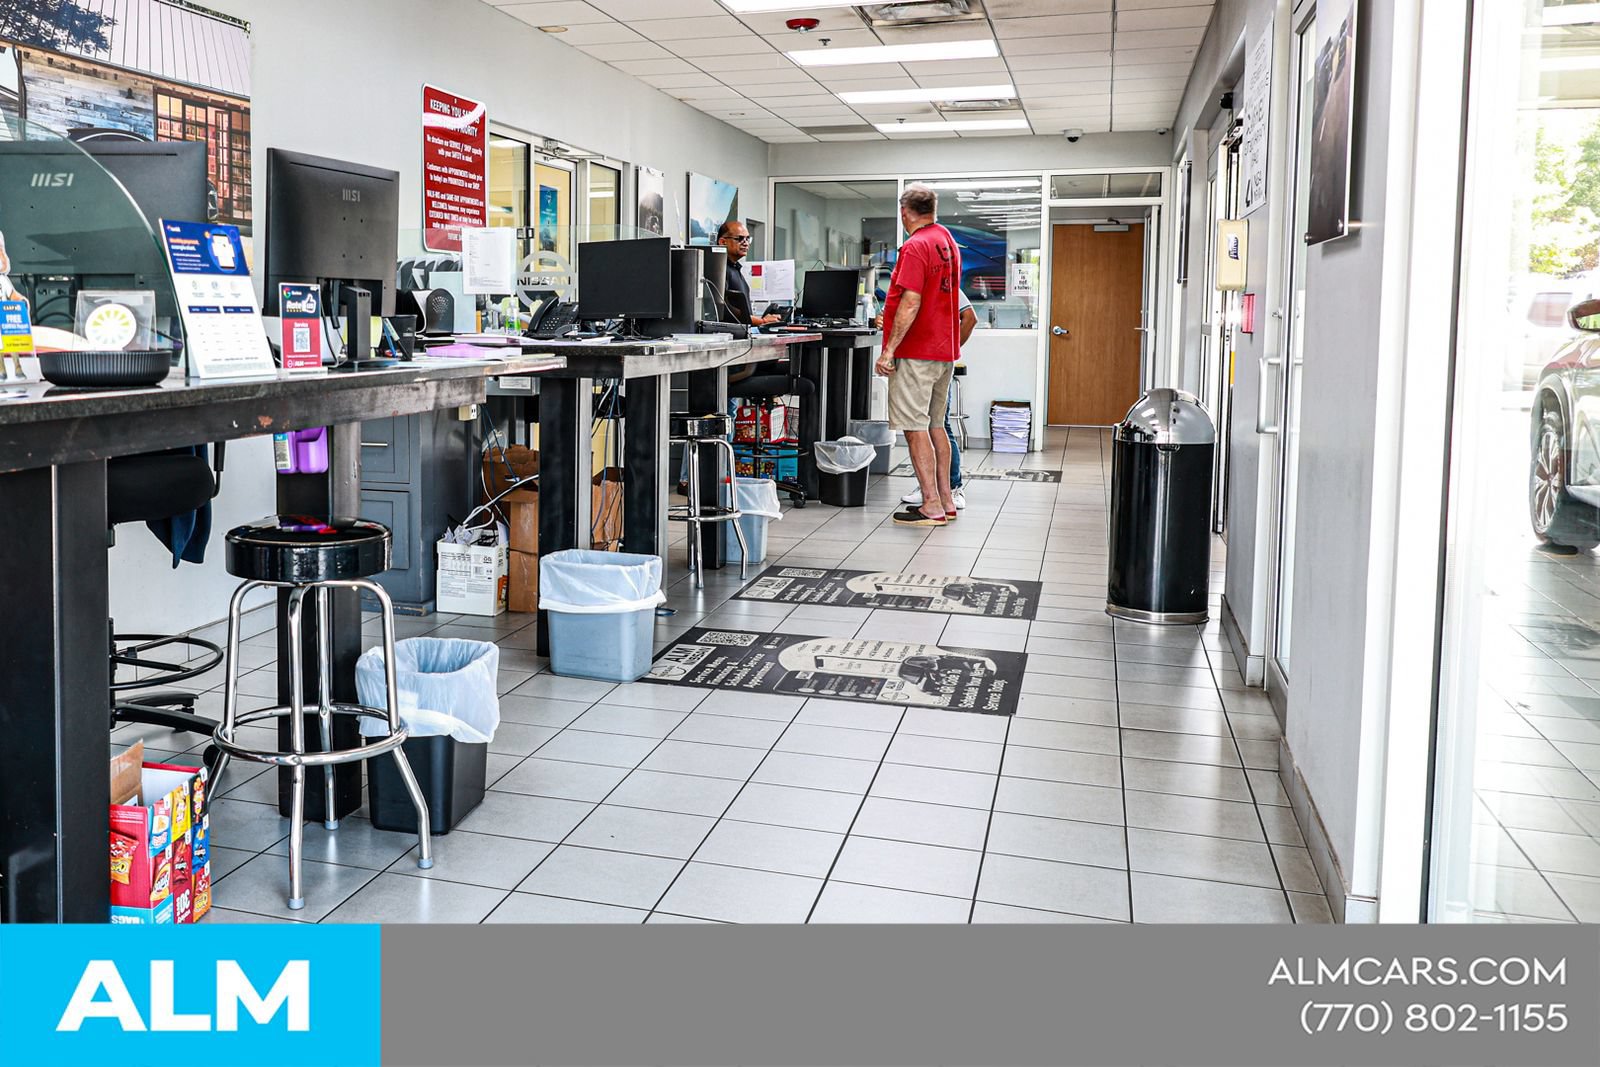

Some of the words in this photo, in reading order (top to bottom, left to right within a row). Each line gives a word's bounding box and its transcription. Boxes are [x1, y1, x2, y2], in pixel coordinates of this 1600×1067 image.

[31, 173, 74, 187] MSI
[342, 188, 361, 202] MSI
[517, 276, 571, 286] NISSAN
[664, 647, 692, 662] ALM
[743, 653, 765, 668] Service
[689, 667, 714, 683] Service
[743, 661, 776, 688] Appointment
[959, 687, 979, 708] Schedule
[982, 693, 1001, 710] Service
